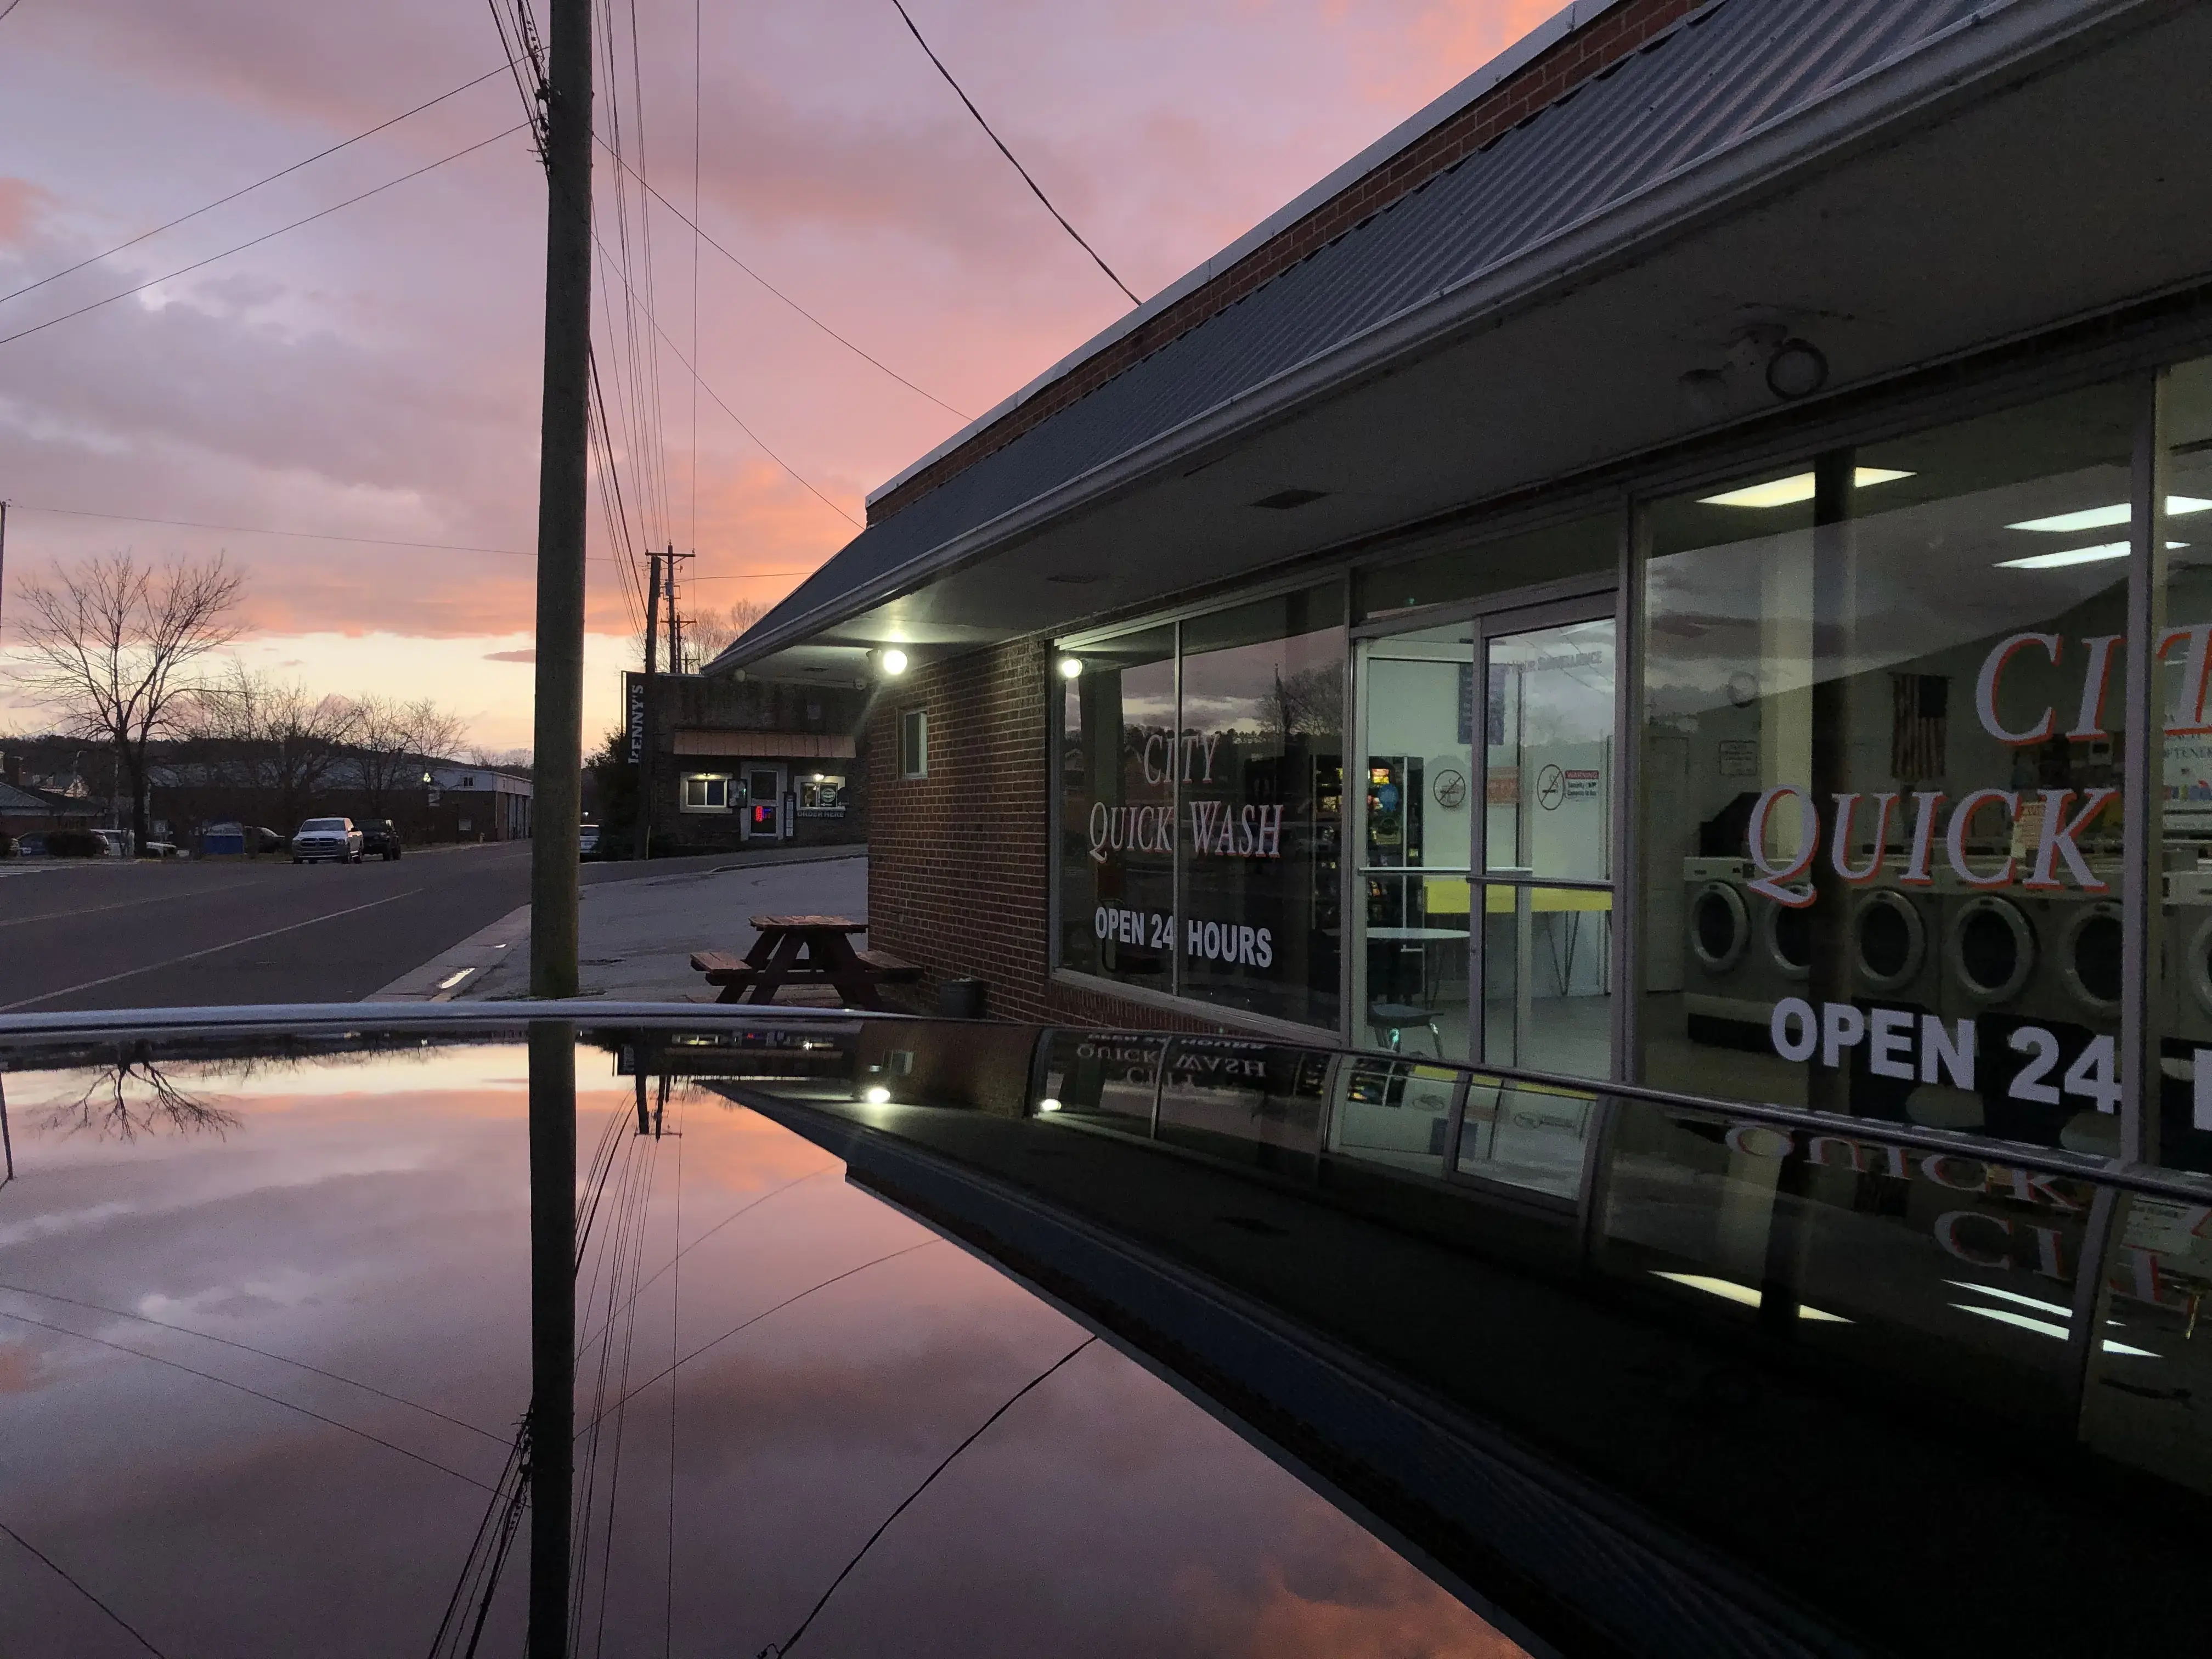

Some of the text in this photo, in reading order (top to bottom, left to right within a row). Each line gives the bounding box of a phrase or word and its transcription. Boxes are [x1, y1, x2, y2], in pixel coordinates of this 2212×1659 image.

[1144, 733, 1221, 786] CITY
[1090, 800, 1284, 864] QUICK WASH
[1747, 785, 2120, 909] QUICK
[1096, 906, 1272, 968] OPEN 24 HOURS
[1771, 997, 1977, 1091] OPEN
[2006, 1026, 2123, 1115] 24
